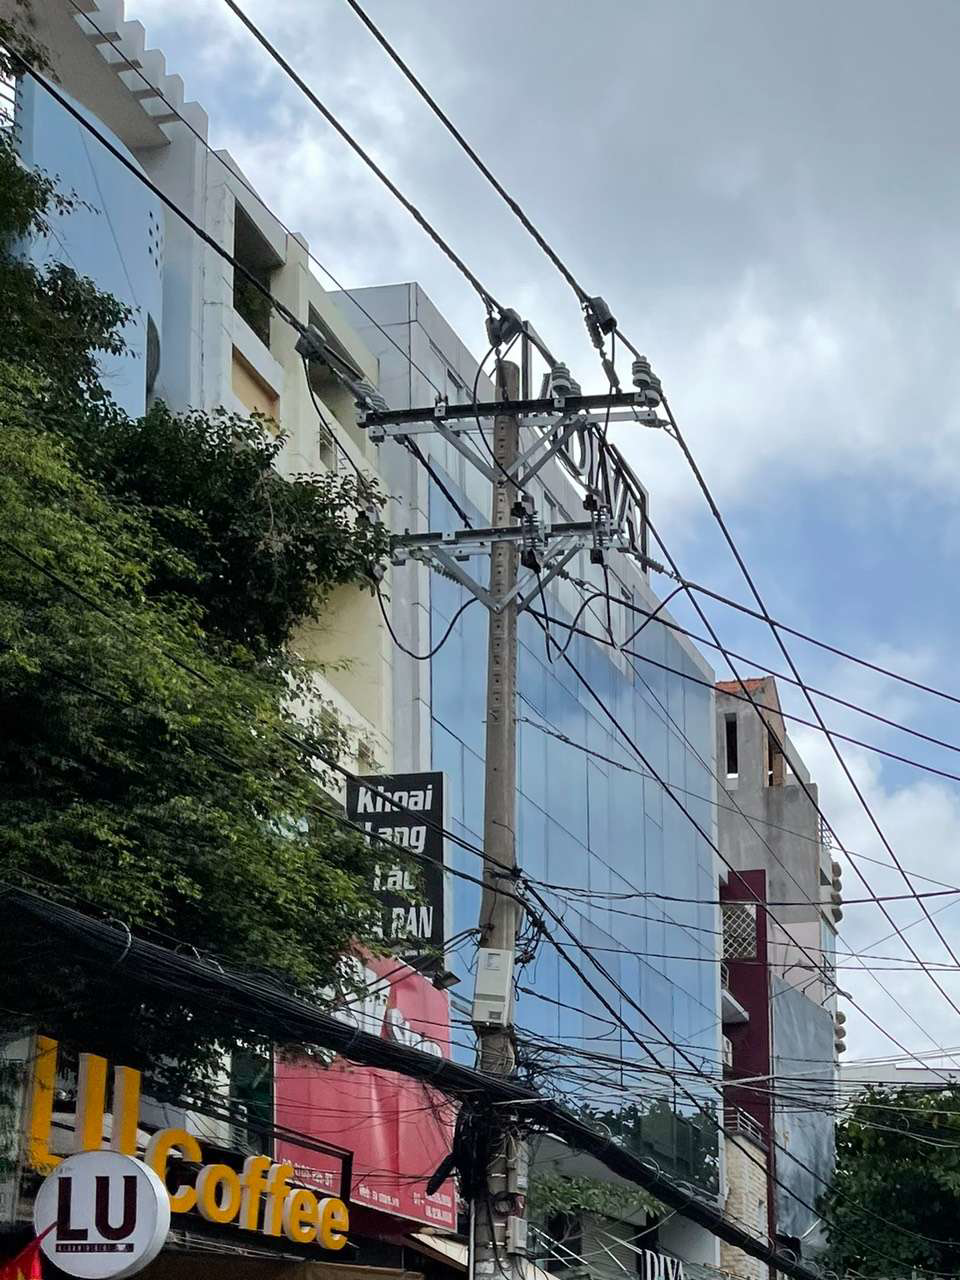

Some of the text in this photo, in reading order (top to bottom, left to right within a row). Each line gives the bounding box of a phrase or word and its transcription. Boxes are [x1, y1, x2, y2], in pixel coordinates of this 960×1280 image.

[356, 784, 433, 814] Khoai
[56, 1175, 137, 1241] LU
[146, 1128, 350, 1250] Coffee
